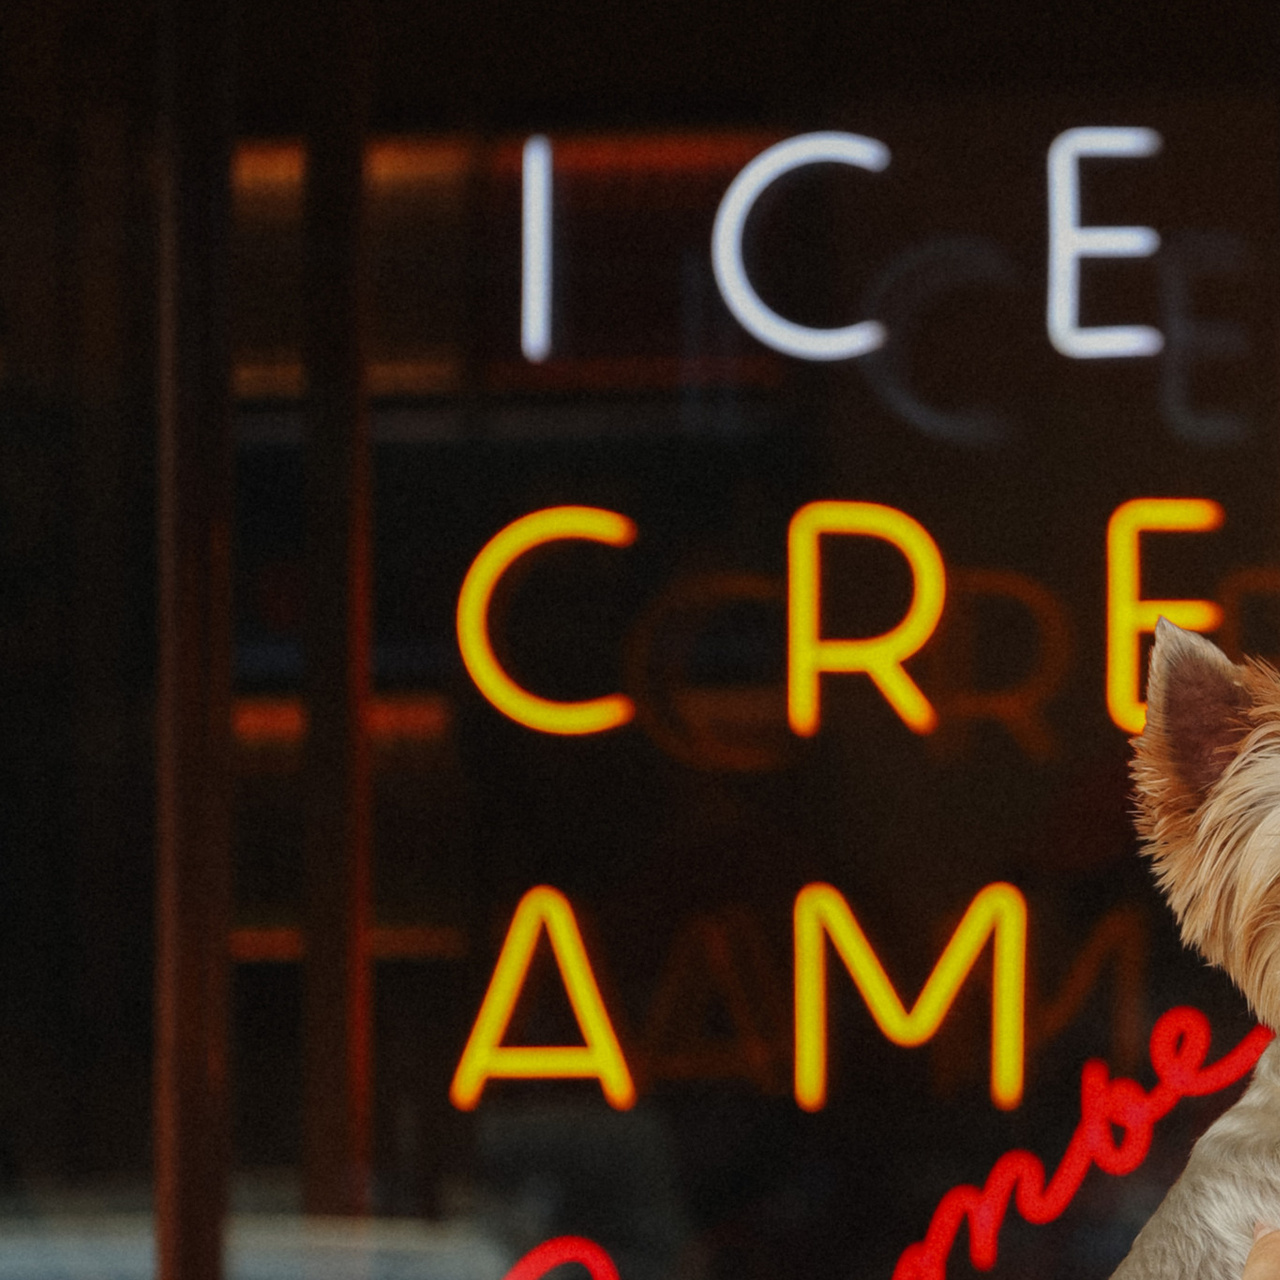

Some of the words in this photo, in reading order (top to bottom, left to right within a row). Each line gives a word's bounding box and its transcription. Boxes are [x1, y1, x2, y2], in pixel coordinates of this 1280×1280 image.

[519, 125, 1164, 363] ICE
[455, 496, 1226, 736] CRE
[449, 880, 1029, 1113] AM
